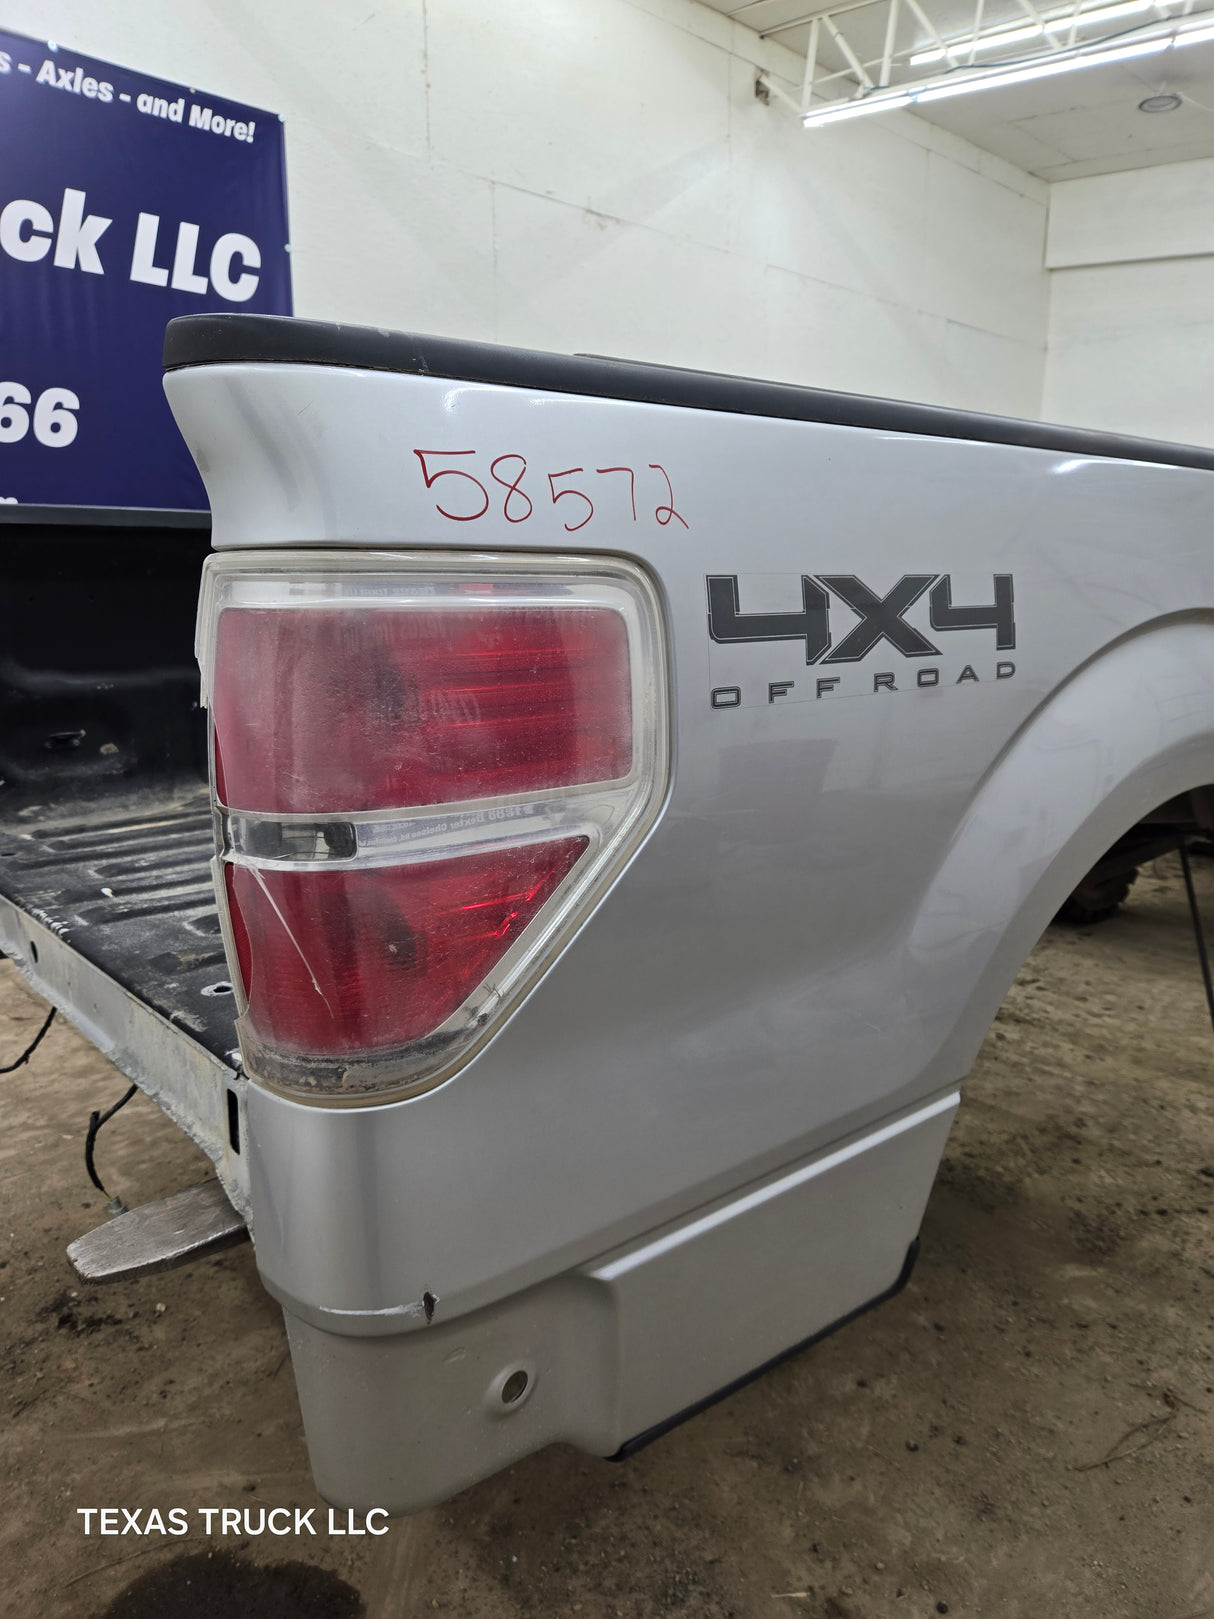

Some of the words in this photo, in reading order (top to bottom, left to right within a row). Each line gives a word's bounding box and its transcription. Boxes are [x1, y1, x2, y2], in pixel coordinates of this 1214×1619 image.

[35, 59, 114, 103] Axles
[136, 93, 185, 124] and
[188, 103, 256, 144] More!
[0, 187, 113, 276] ck
[129, 211, 262, 303] LLC
[0, 381, 80, 449] 66
[413, 448, 690, 532] 58572
[711, 676, 842, 710] OFF
[873, 660, 1016, 693] ROAD
